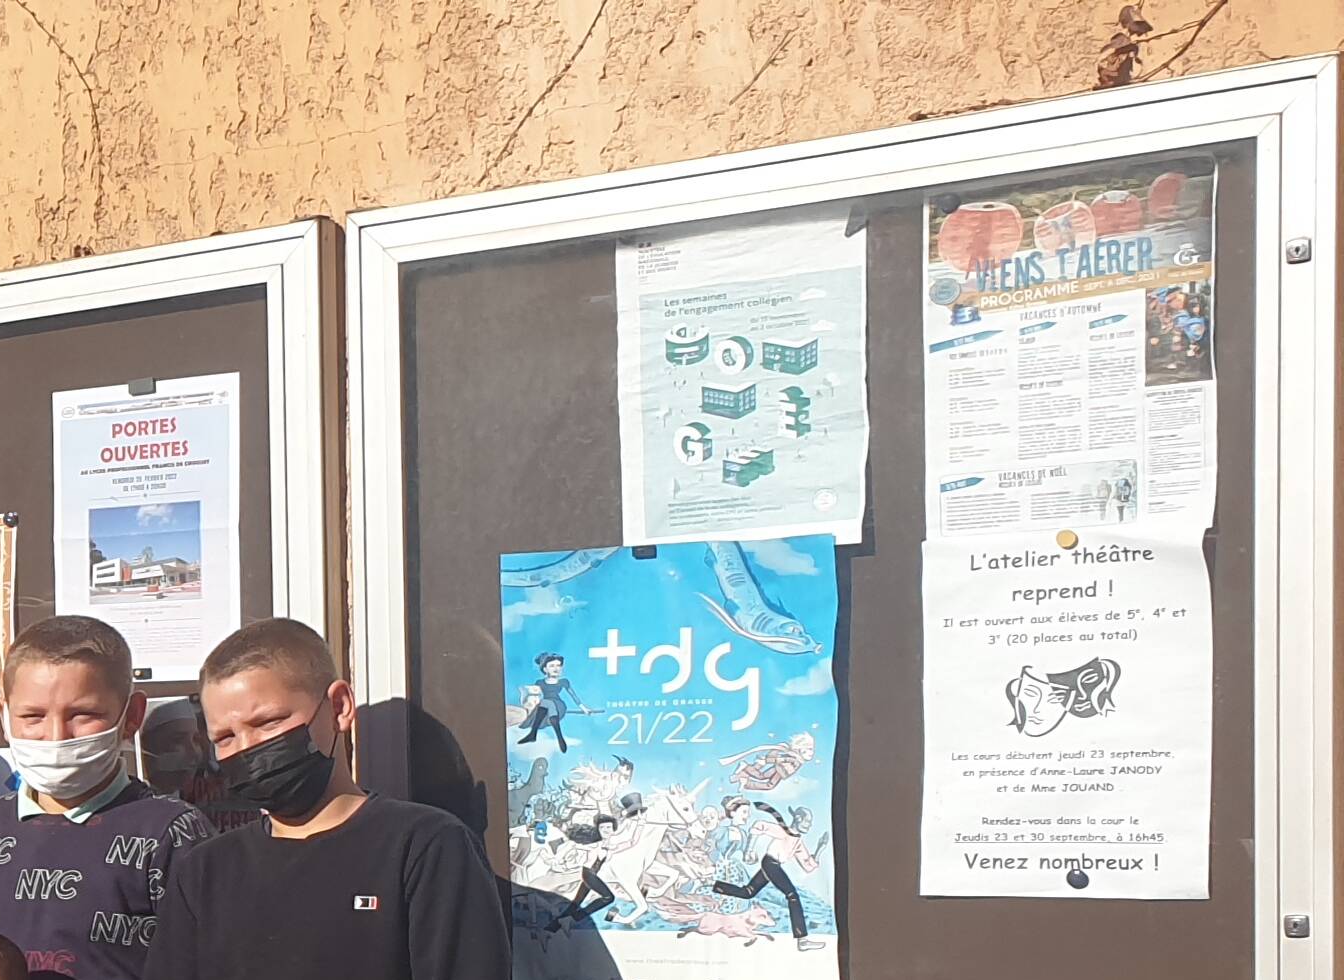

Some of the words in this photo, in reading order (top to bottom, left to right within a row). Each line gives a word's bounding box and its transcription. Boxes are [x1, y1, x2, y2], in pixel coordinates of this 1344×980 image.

[980, 281, 1079, 311] PROGRAMME
[111, 417, 177, 438] PORTES
[100, 440, 189, 463] OUVERTES
[970, 550, 1061, 571] L'atelier
[1071, 544, 1155, 565] théâtre
[1012, 581, 1097, 605] reprend
[1108, 579, 1114, 597] !
[943, 618, 953, 628] Il
[959, 617, 979, 627] est
[985, 615, 1024, 626] ouvert
[1030, 615, 1053, 624] aux
[1058, 610, 1098, 623] élèves
[1105, 610, 1120, 621] de
[1172, 607, 1186, 618] et
[1006, 633, 1028, 646] (20
[1033, 631, 1073, 645] places
[1079, 632, 1094, 641] au
[1100, 628, 1138, 642] total)
[607, 711, 713, 745] 21/22
[951, 752, 969, 761] Les
[973, 753, 1001, 761] cours
[1005, 751, 1053, 761] débutent
[1057, 749, 1085, 762] jeudi
[1090, 749, 1105, 760] 23
[962, 768, 975, 777] en
[979, 766, 1025, 778] présence
[1110, 765, 1163, 775] JANODY
[996, 784, 1009, 793] et
[1012, 783, 1026, 792] de
[1030, 784, 1057, 793] Mme
[1061, 783, 1115, 792] JOUAND
[981, 816, 1052, 826] Rendez-vous
[1056, 815, 1082, 825] dans
[1086, 815, 1096, 825] la
[1100, 817, 1125, 826] cour
[1129, 815, 1140, 825] le
[954, 832, 990, 842] Jeudis
[994, 832, 1009, 842] 23
[1013, 833, 1026, 842] et
[1030, 832, 1045, 842] 30
[1116, 832, 1123, 842] à
[105, 835, 160, 869] NY
[964, 852, 1029, 870] Venez
[1039, 852, 1144, 871] nombreux
[1154, 852, 1160, 870] !
[14, 868, 82, 900] NYC
